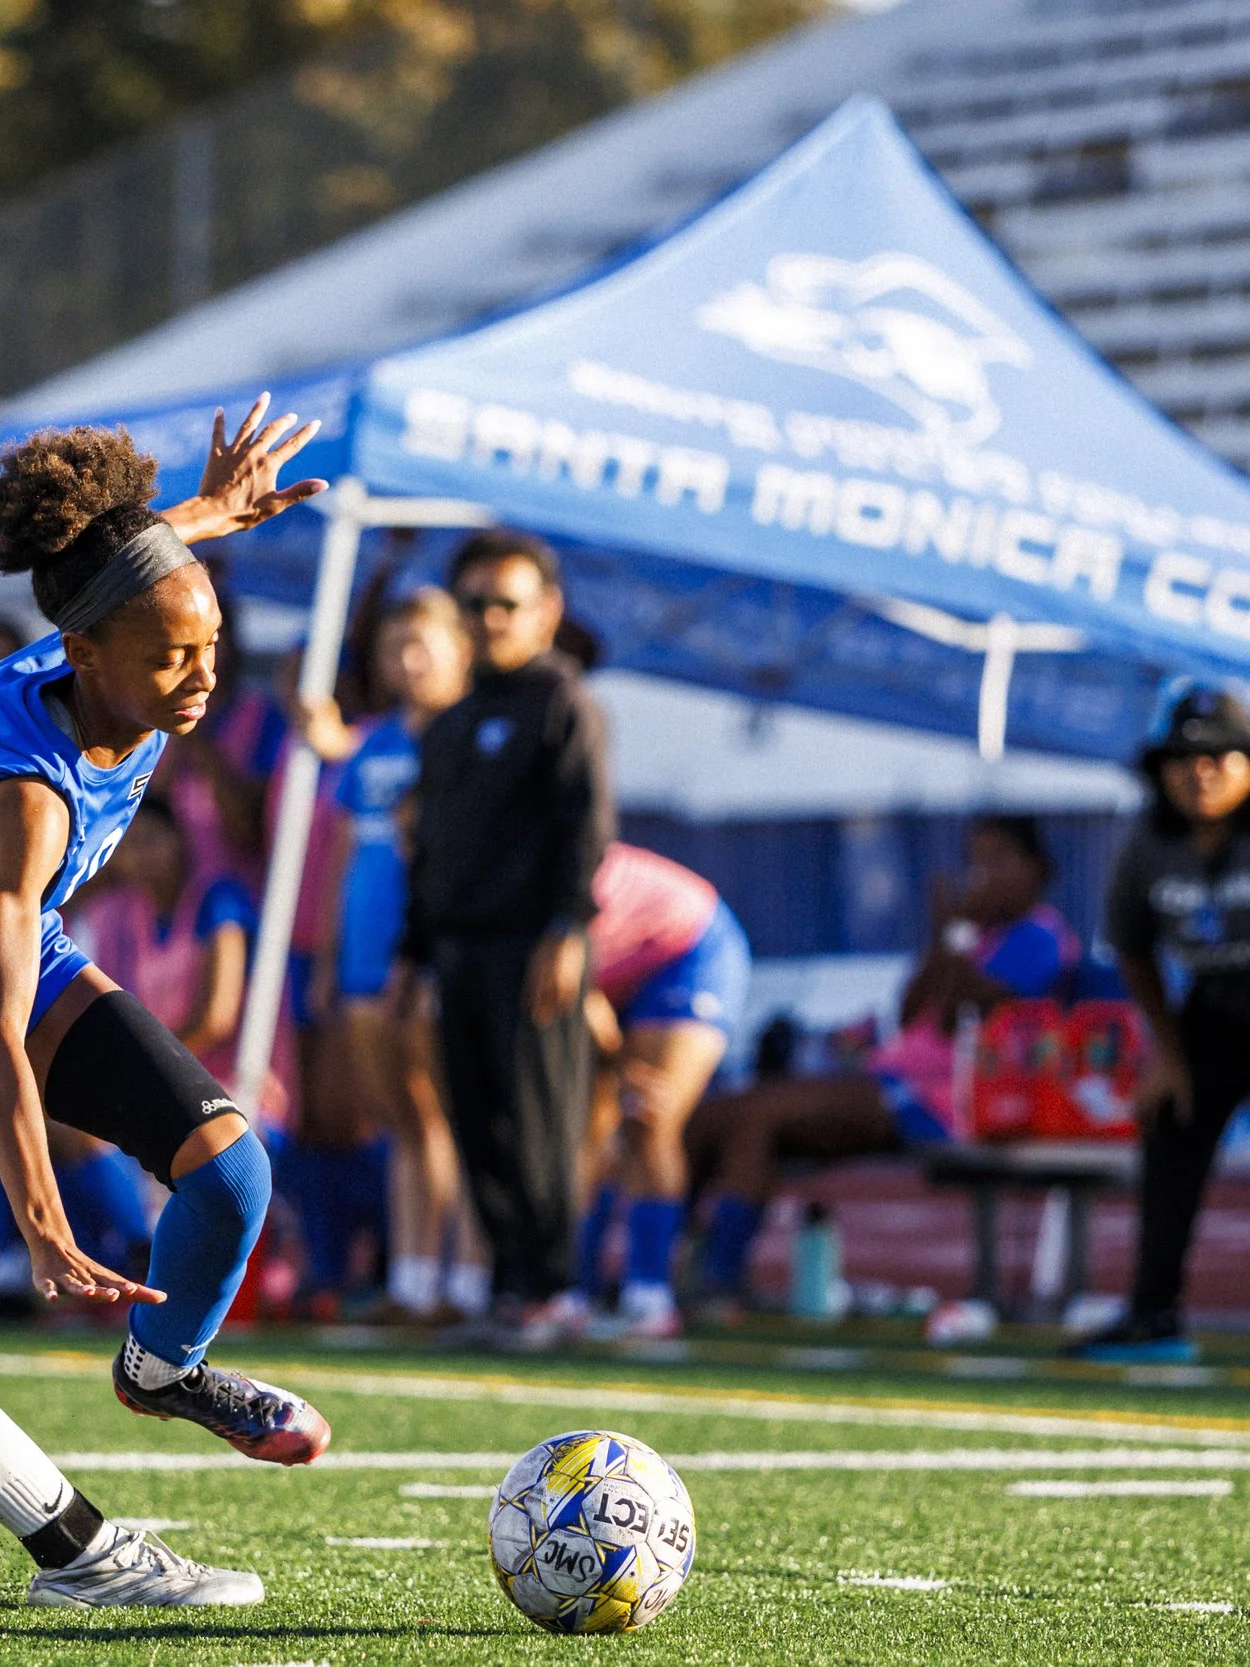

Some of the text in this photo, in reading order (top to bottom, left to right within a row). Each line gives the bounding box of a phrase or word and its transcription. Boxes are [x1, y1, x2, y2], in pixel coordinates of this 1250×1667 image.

[402, 387, 730, 516] SANTA
[752, 462, 1124, 602] MONICA
[543, 1539, 596, 1583] SMC
